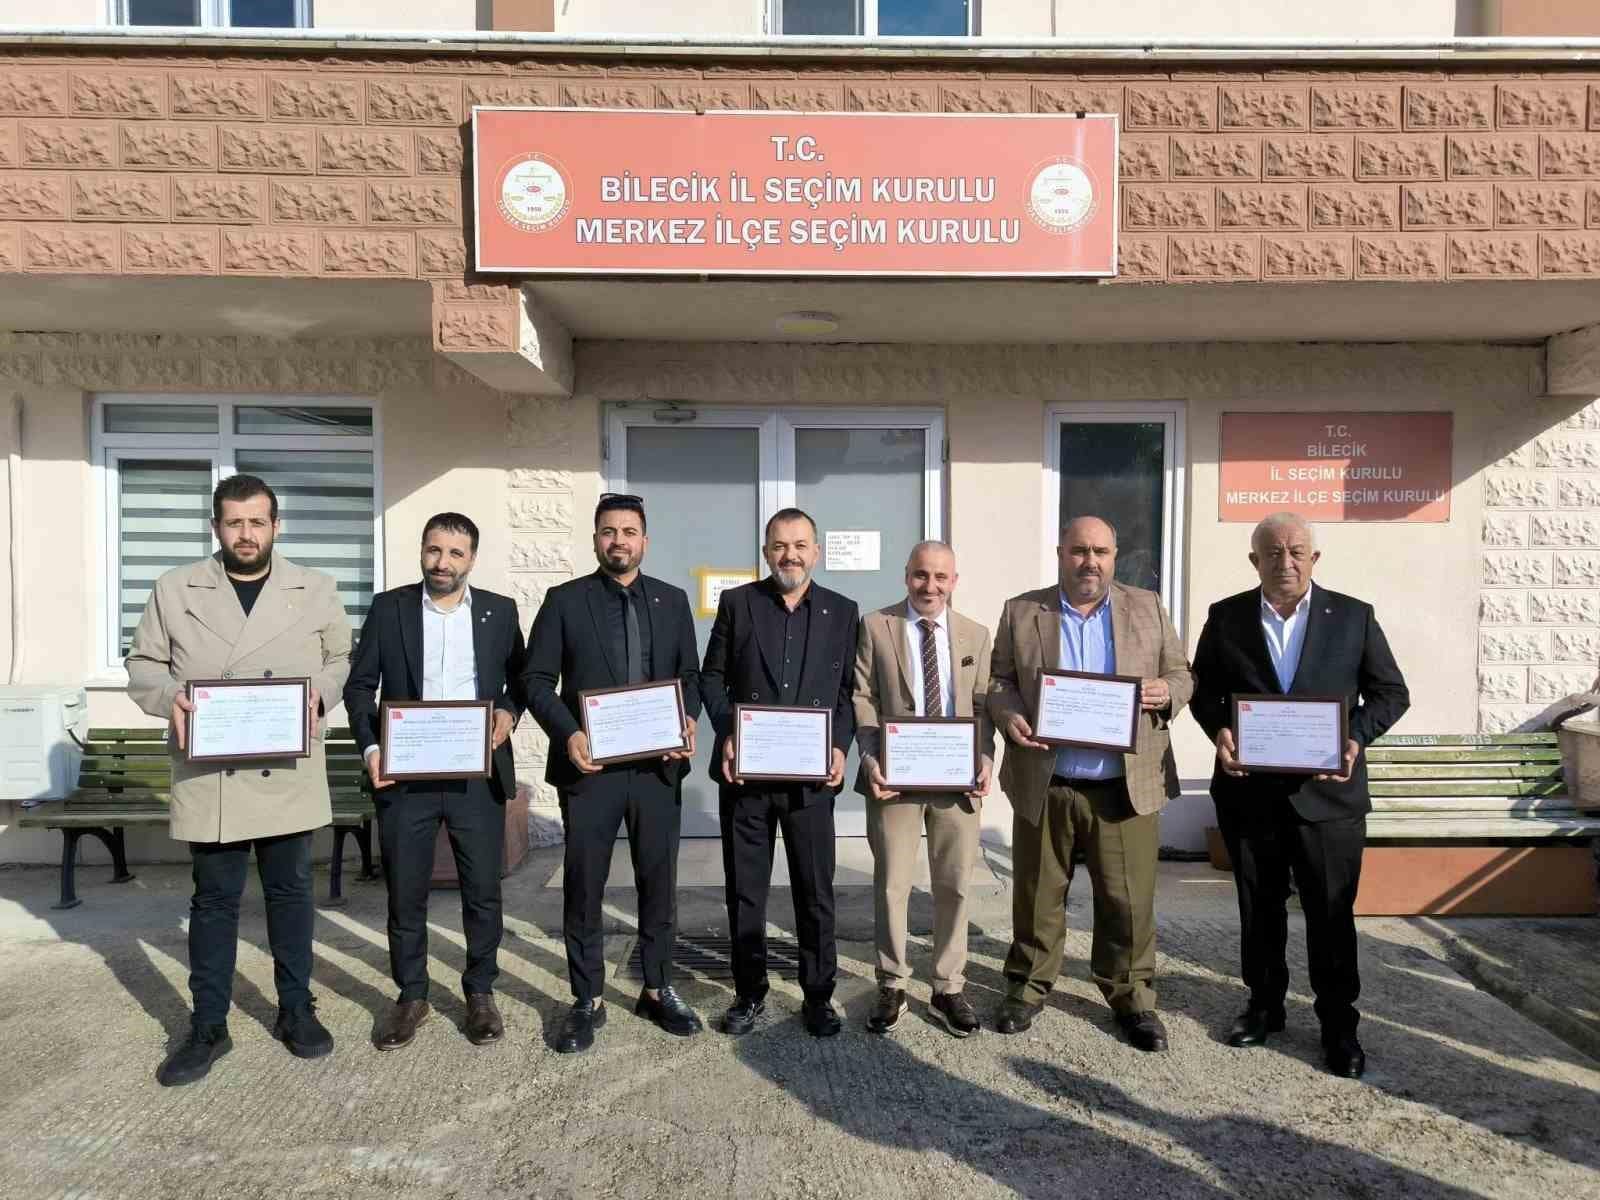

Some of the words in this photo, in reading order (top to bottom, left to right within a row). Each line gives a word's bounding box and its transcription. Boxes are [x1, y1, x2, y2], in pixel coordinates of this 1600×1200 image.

[769, 135, 825, 162] T.C.
[600, 170, 721, 203] BİLECİK
[729, 170, 756, 202] İL
[764, 171, 862, 209] SEÇİM
[871, 176, 997, 203] KURULU
[575, 217, 706, 244] MERKEZ
[714, 211, 782, 251] İLÇE
[789, 213, 888, 251] SEÇİM
[896, 217, 1021, 244] KURULU
[1325, 425, 1352, 437] T.C.
[1307, 442, 1367, 457] BİLECİK
[1271, 465, 1284, 481] İL
[1288, 466, 1335, 483] SEÇİM
[1340, 466, 1402, 480] KURULU
[1226, 490, 1289, 505] MERKEZ
[1294, 488, 1328, 505] İLÇE
[1332, 488, 1379, 505] SEÇİM
[1384, 488, 1446, 503] KURULU
